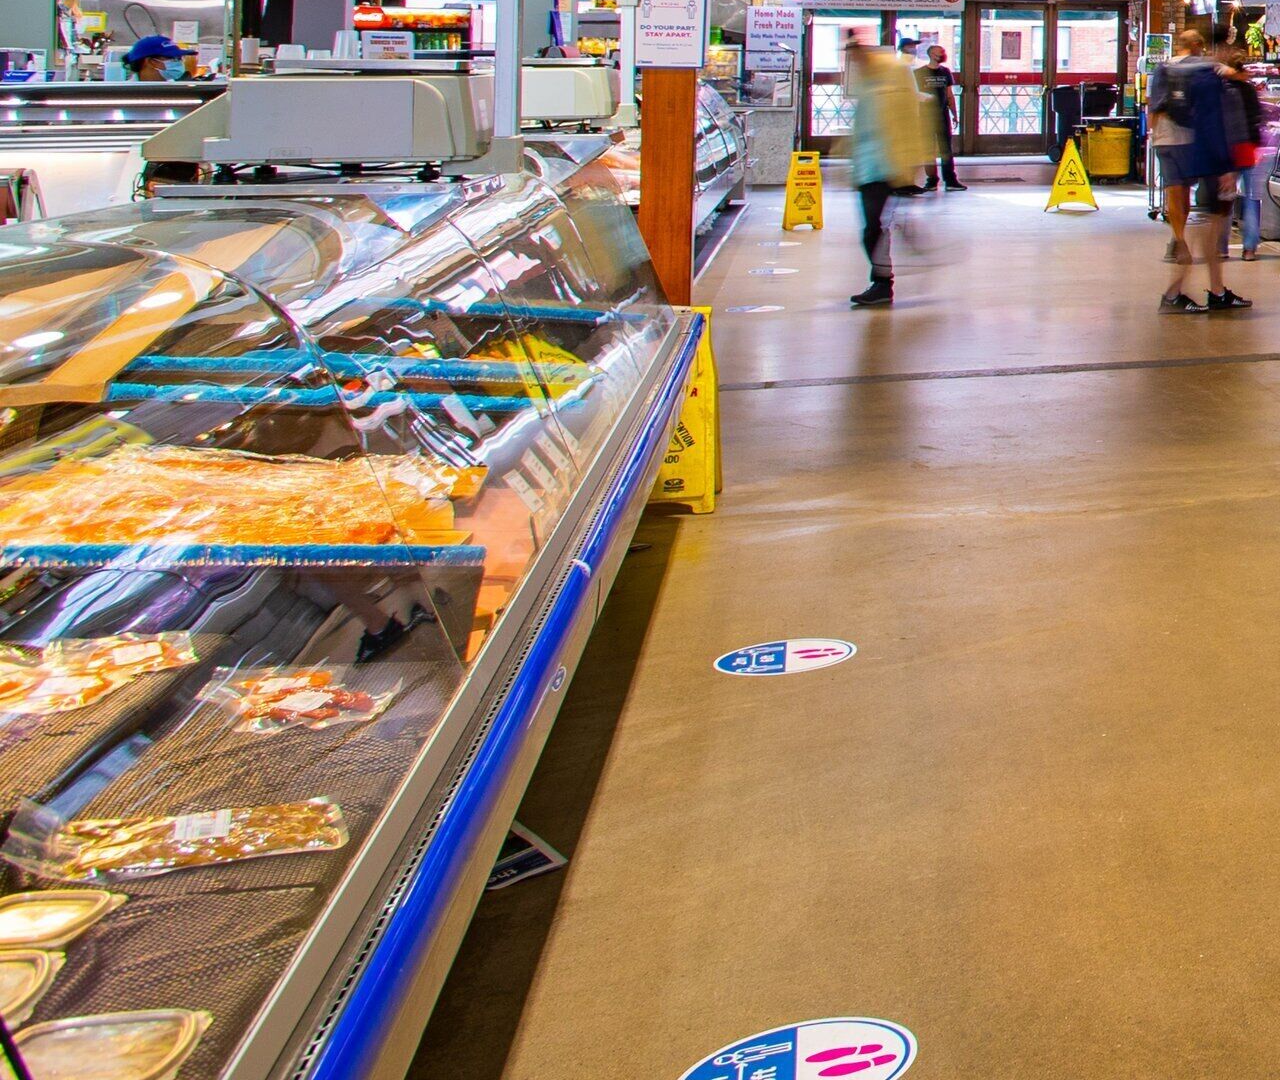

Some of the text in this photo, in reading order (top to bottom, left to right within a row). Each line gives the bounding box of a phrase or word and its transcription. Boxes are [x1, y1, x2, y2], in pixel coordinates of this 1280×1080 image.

[754, 9, 795, 18] Home Made
[754, 21, 794, 29] Fresh Pasta
